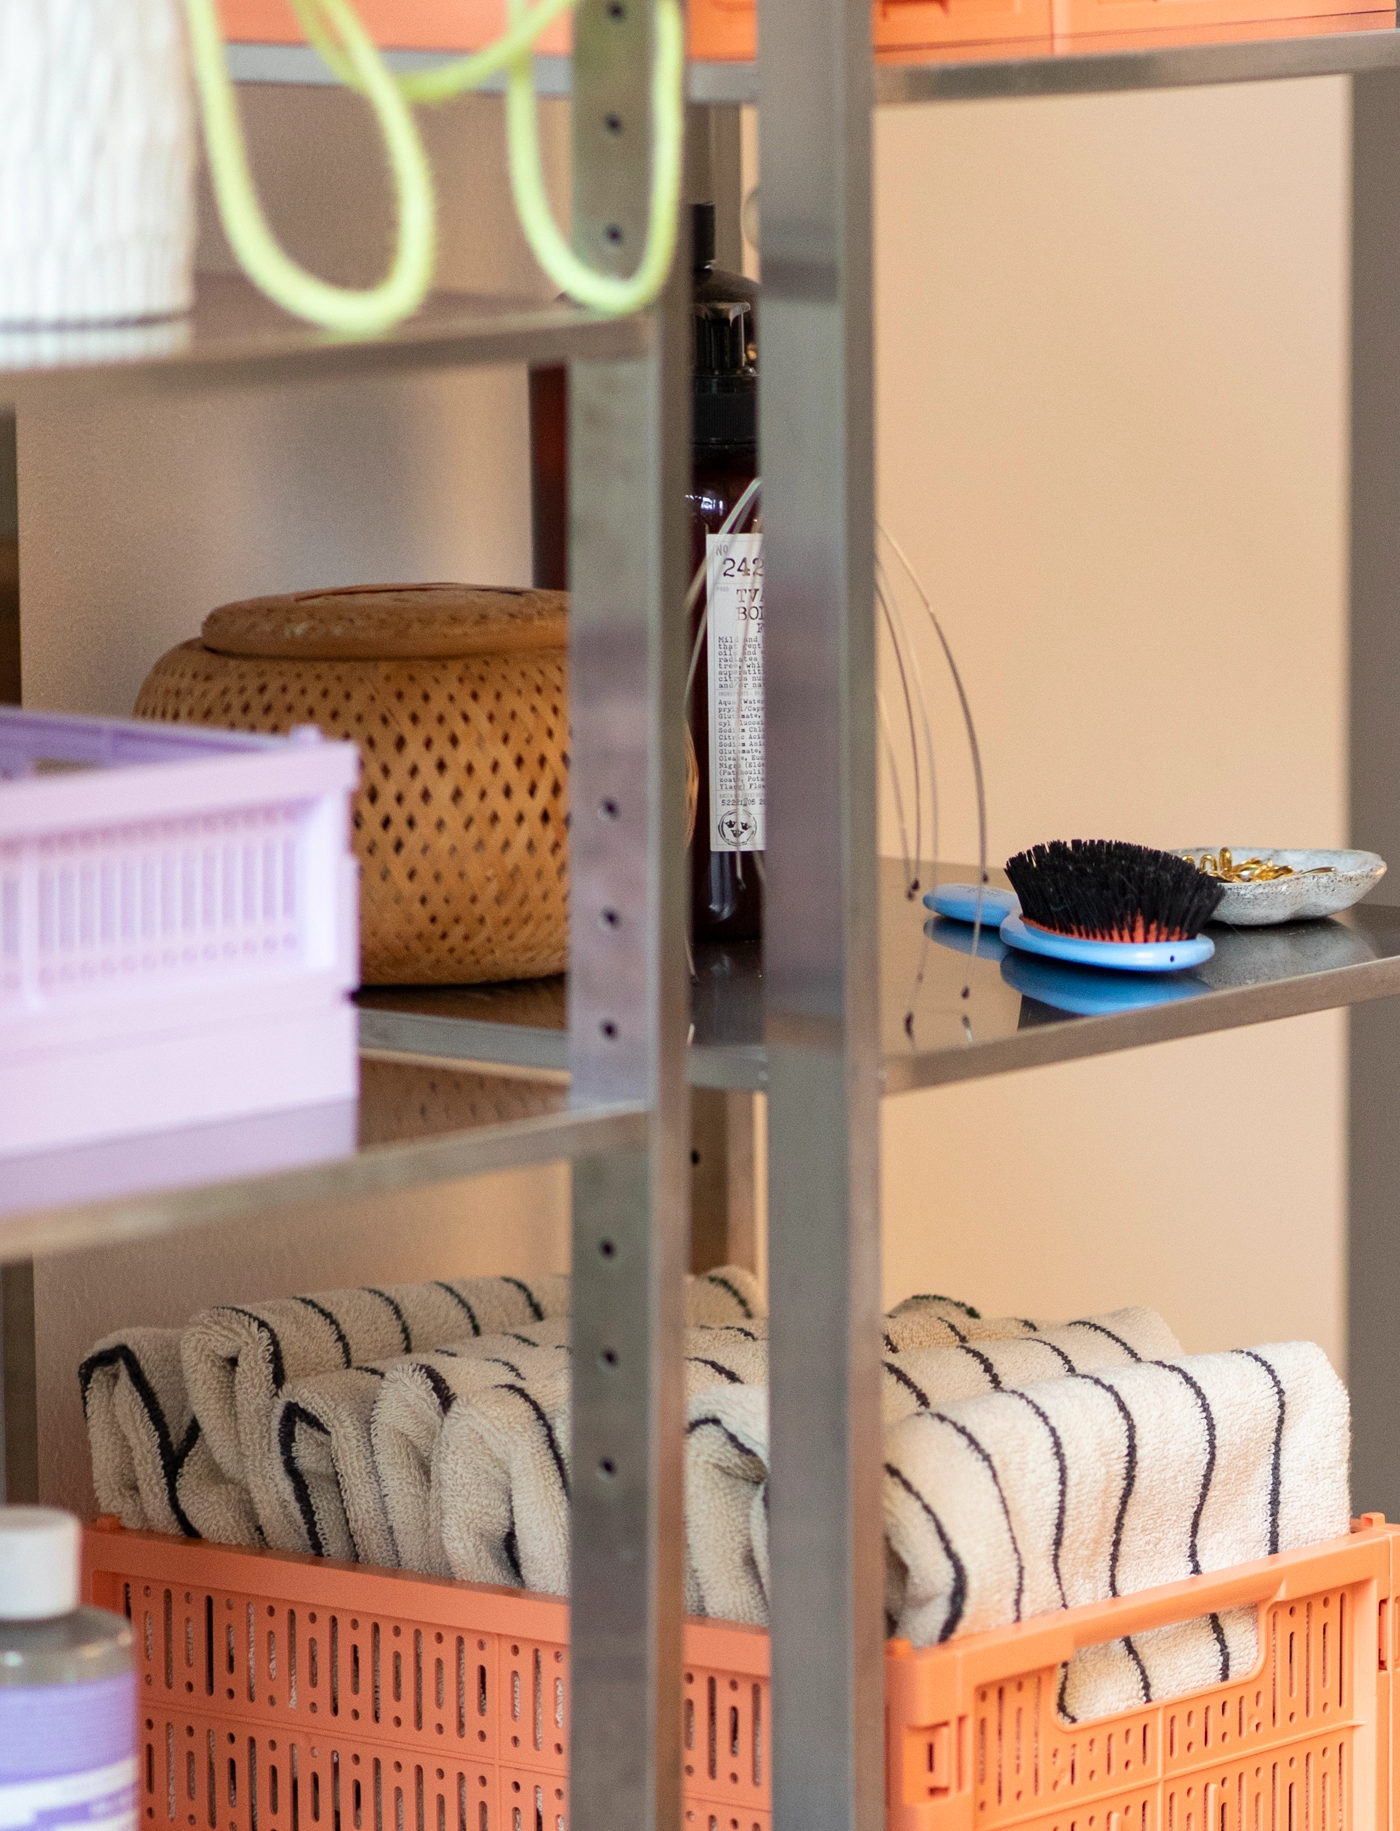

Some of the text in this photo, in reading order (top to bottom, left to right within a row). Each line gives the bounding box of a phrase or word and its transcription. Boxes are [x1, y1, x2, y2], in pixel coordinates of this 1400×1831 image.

[723, 557, 764, 578] 242
[736, 588, 765, 603] TV
[742, 643, 765, 652] gent
